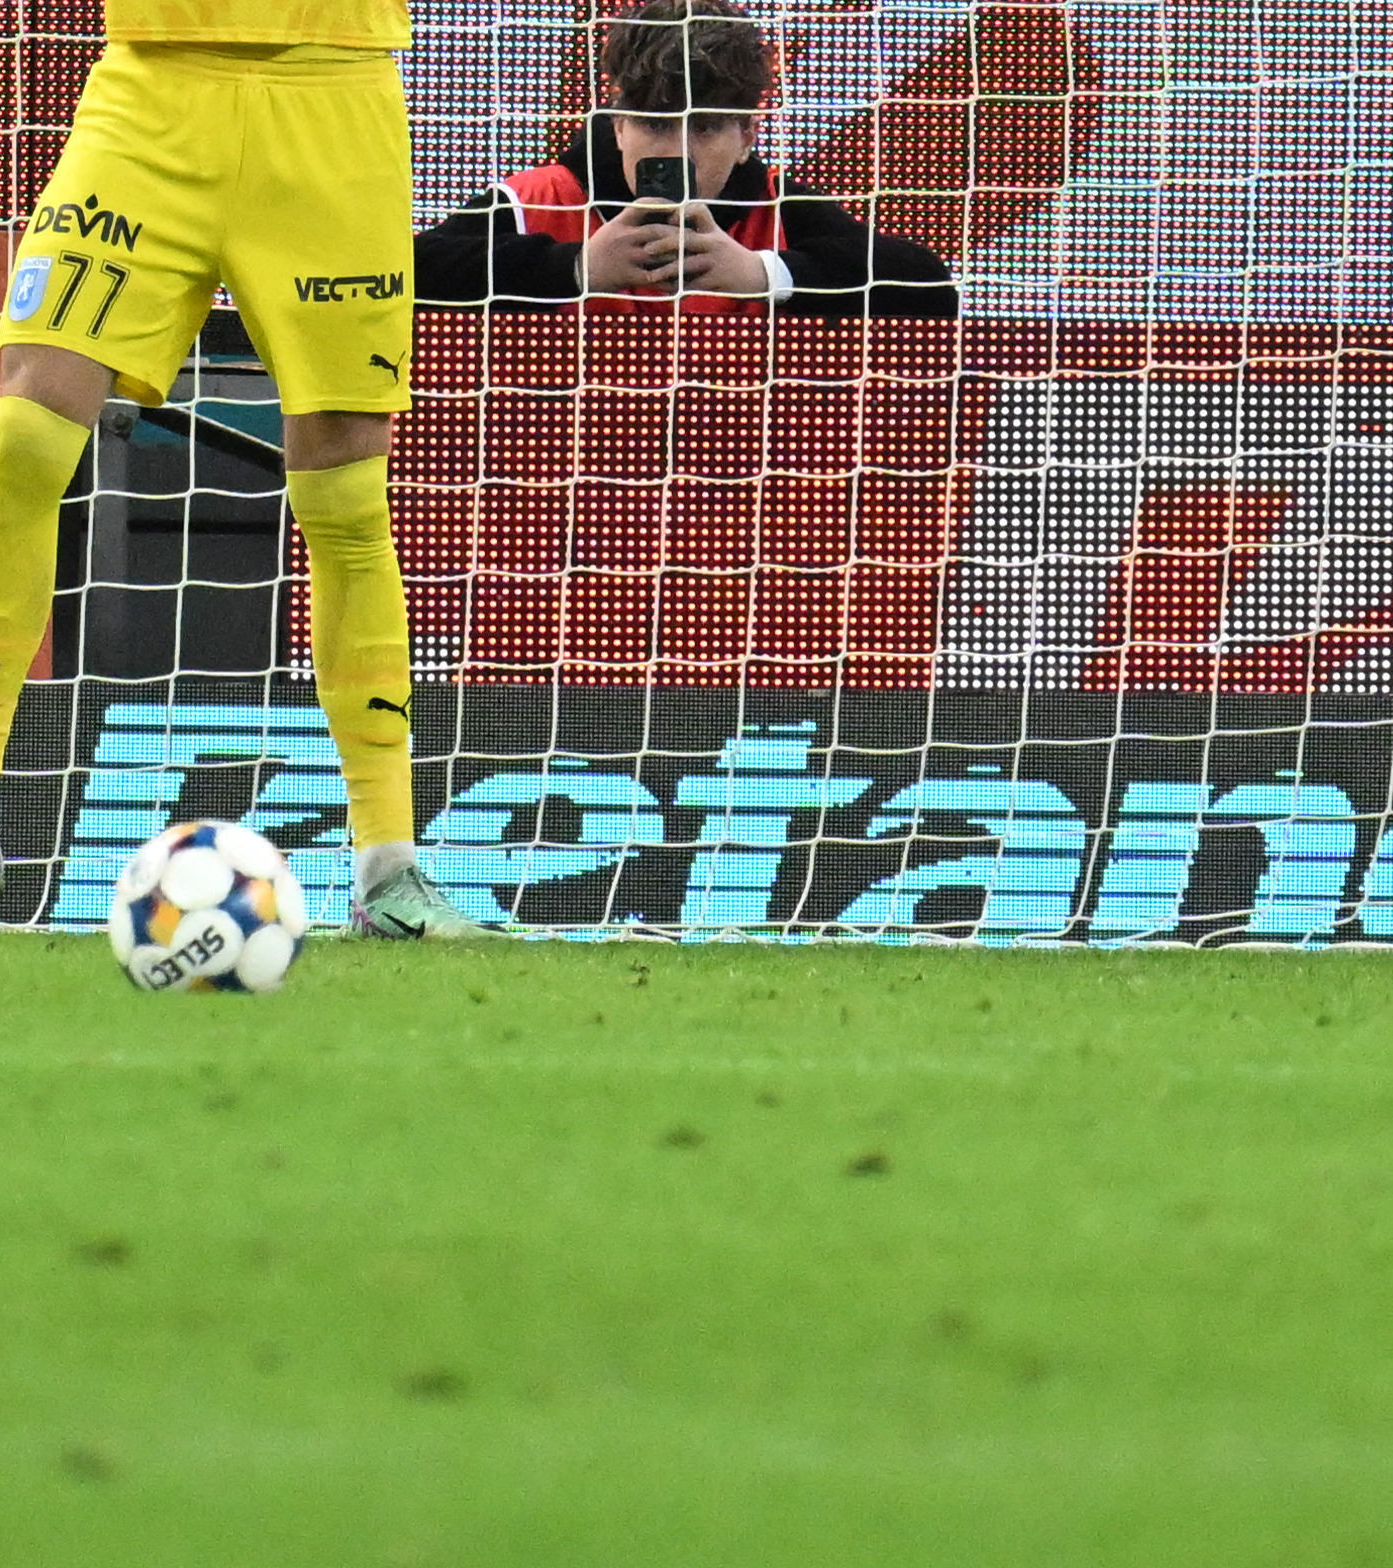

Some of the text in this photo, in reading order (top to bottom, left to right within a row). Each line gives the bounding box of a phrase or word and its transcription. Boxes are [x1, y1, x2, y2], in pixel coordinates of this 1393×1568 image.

[33, 197, 144, 253] DEVIN
[46, 249, 130, 341] 77
[294, 271, 405, 303] VECTRUM
[49, 704, 1393, 946] Betan
